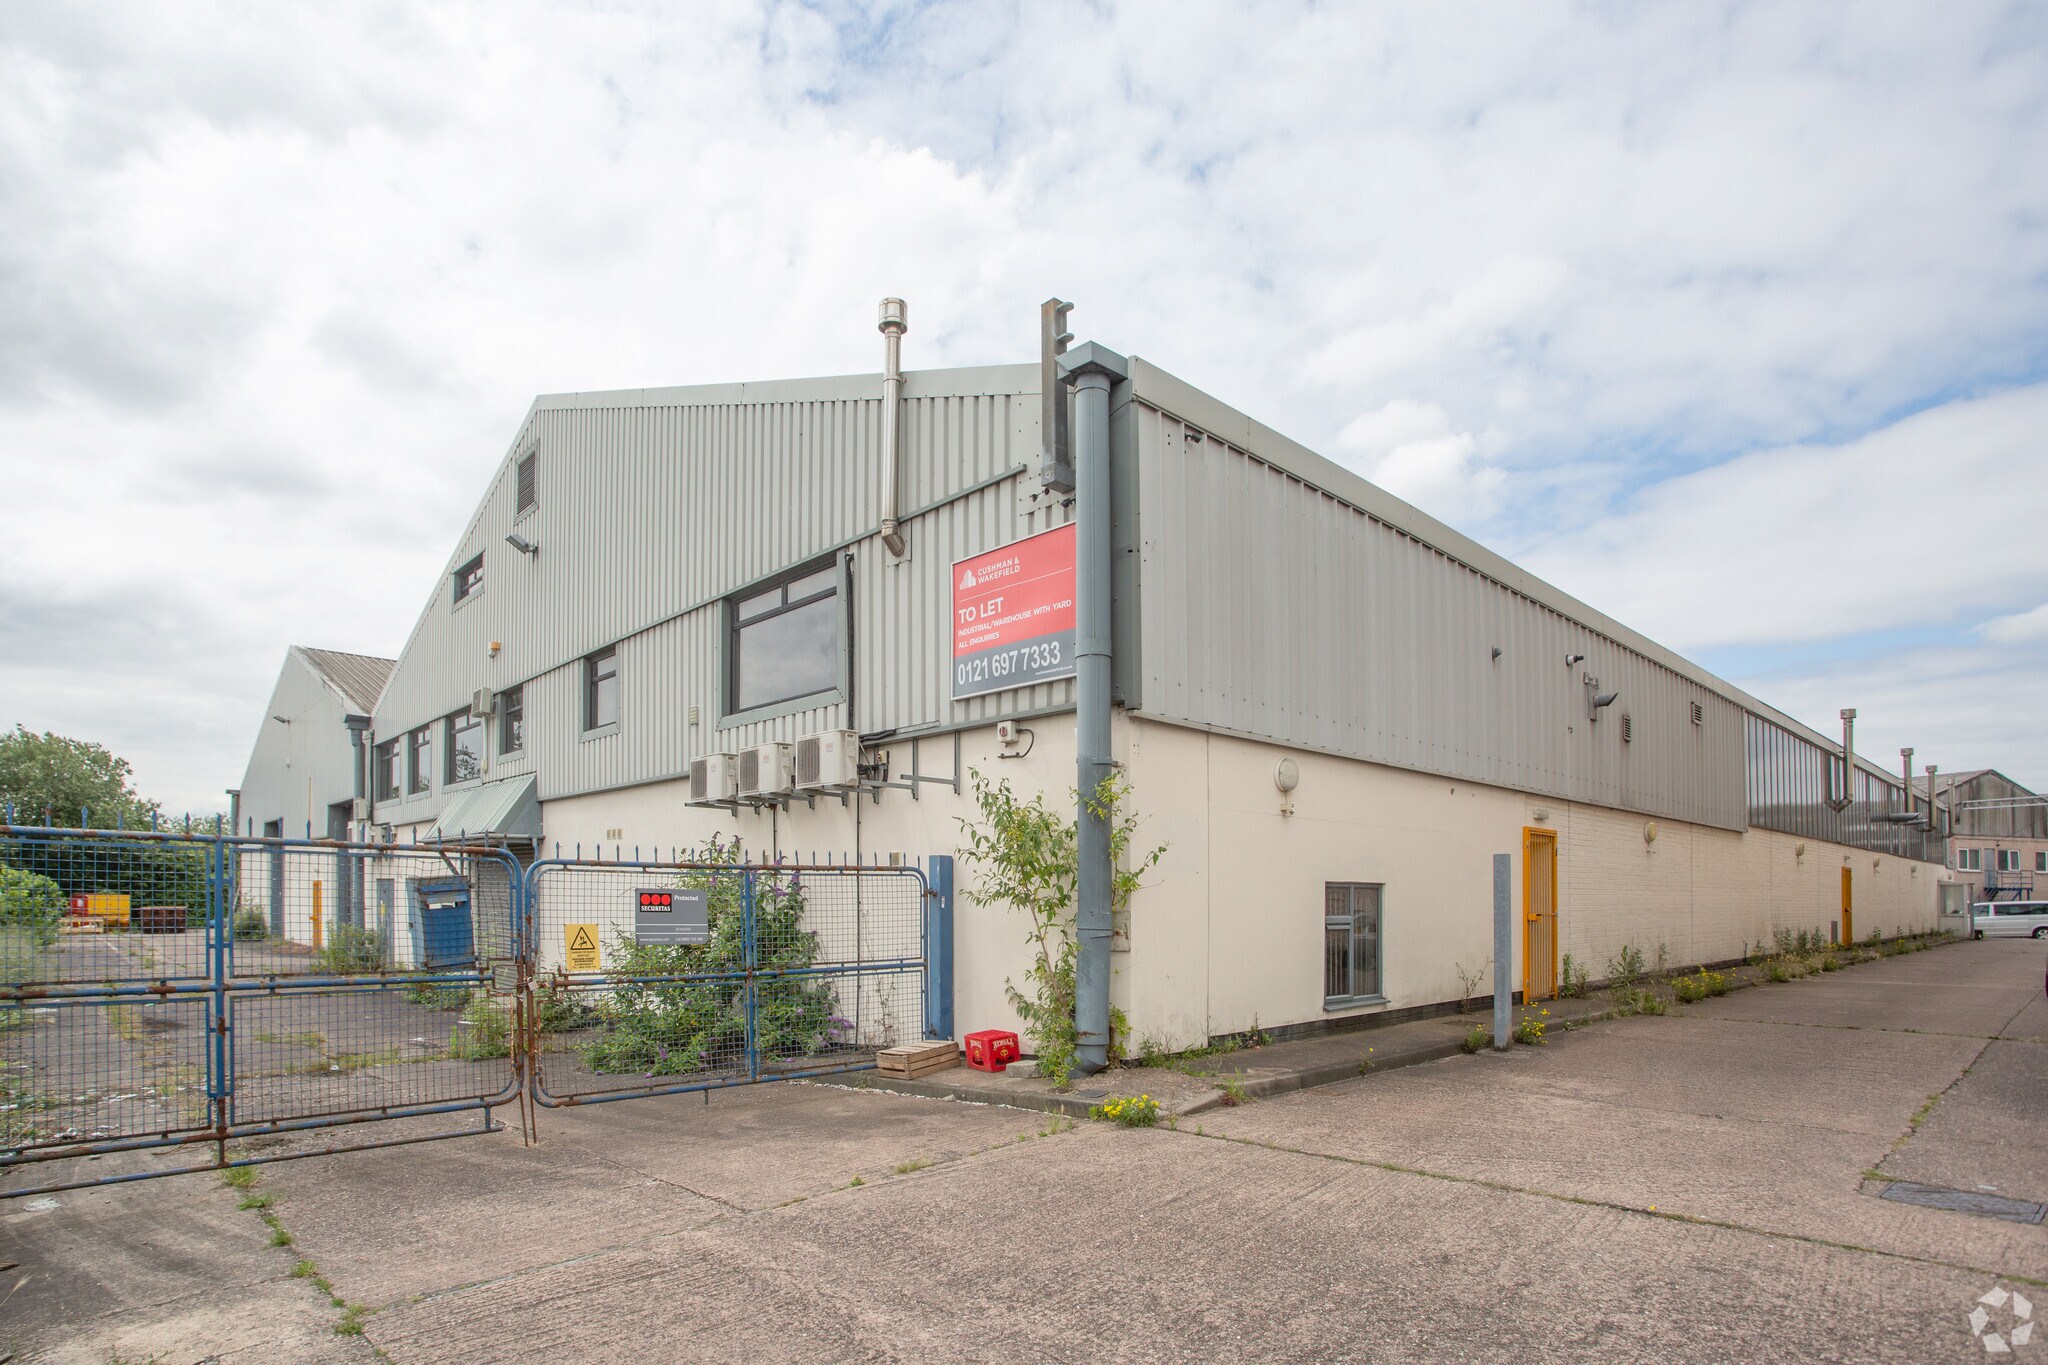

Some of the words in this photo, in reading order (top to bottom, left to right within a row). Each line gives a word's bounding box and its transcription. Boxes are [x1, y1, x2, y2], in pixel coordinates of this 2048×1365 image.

[977, 559, 1013, 576] CUSHMAN
[977, 565, 1021, 584] WAKEFIELD
[957, 610, 1032, 637] INDUSTRIAL/WAREHOUSE
[1033, 605, 1051, 616] WITH
[1052, 599, 1072, 611] YARD
[958, 606, 977, 624] TO
[980, 597, 1004, 618] LET
[958, 640, 968, 648] ALL
[969, 631, 1000, 645] ENQUIRIES
[957, 656, 988, 685] 0121
[991, 650, 1018, 677] 697
[1020, 640, 1061, 671] 7333
